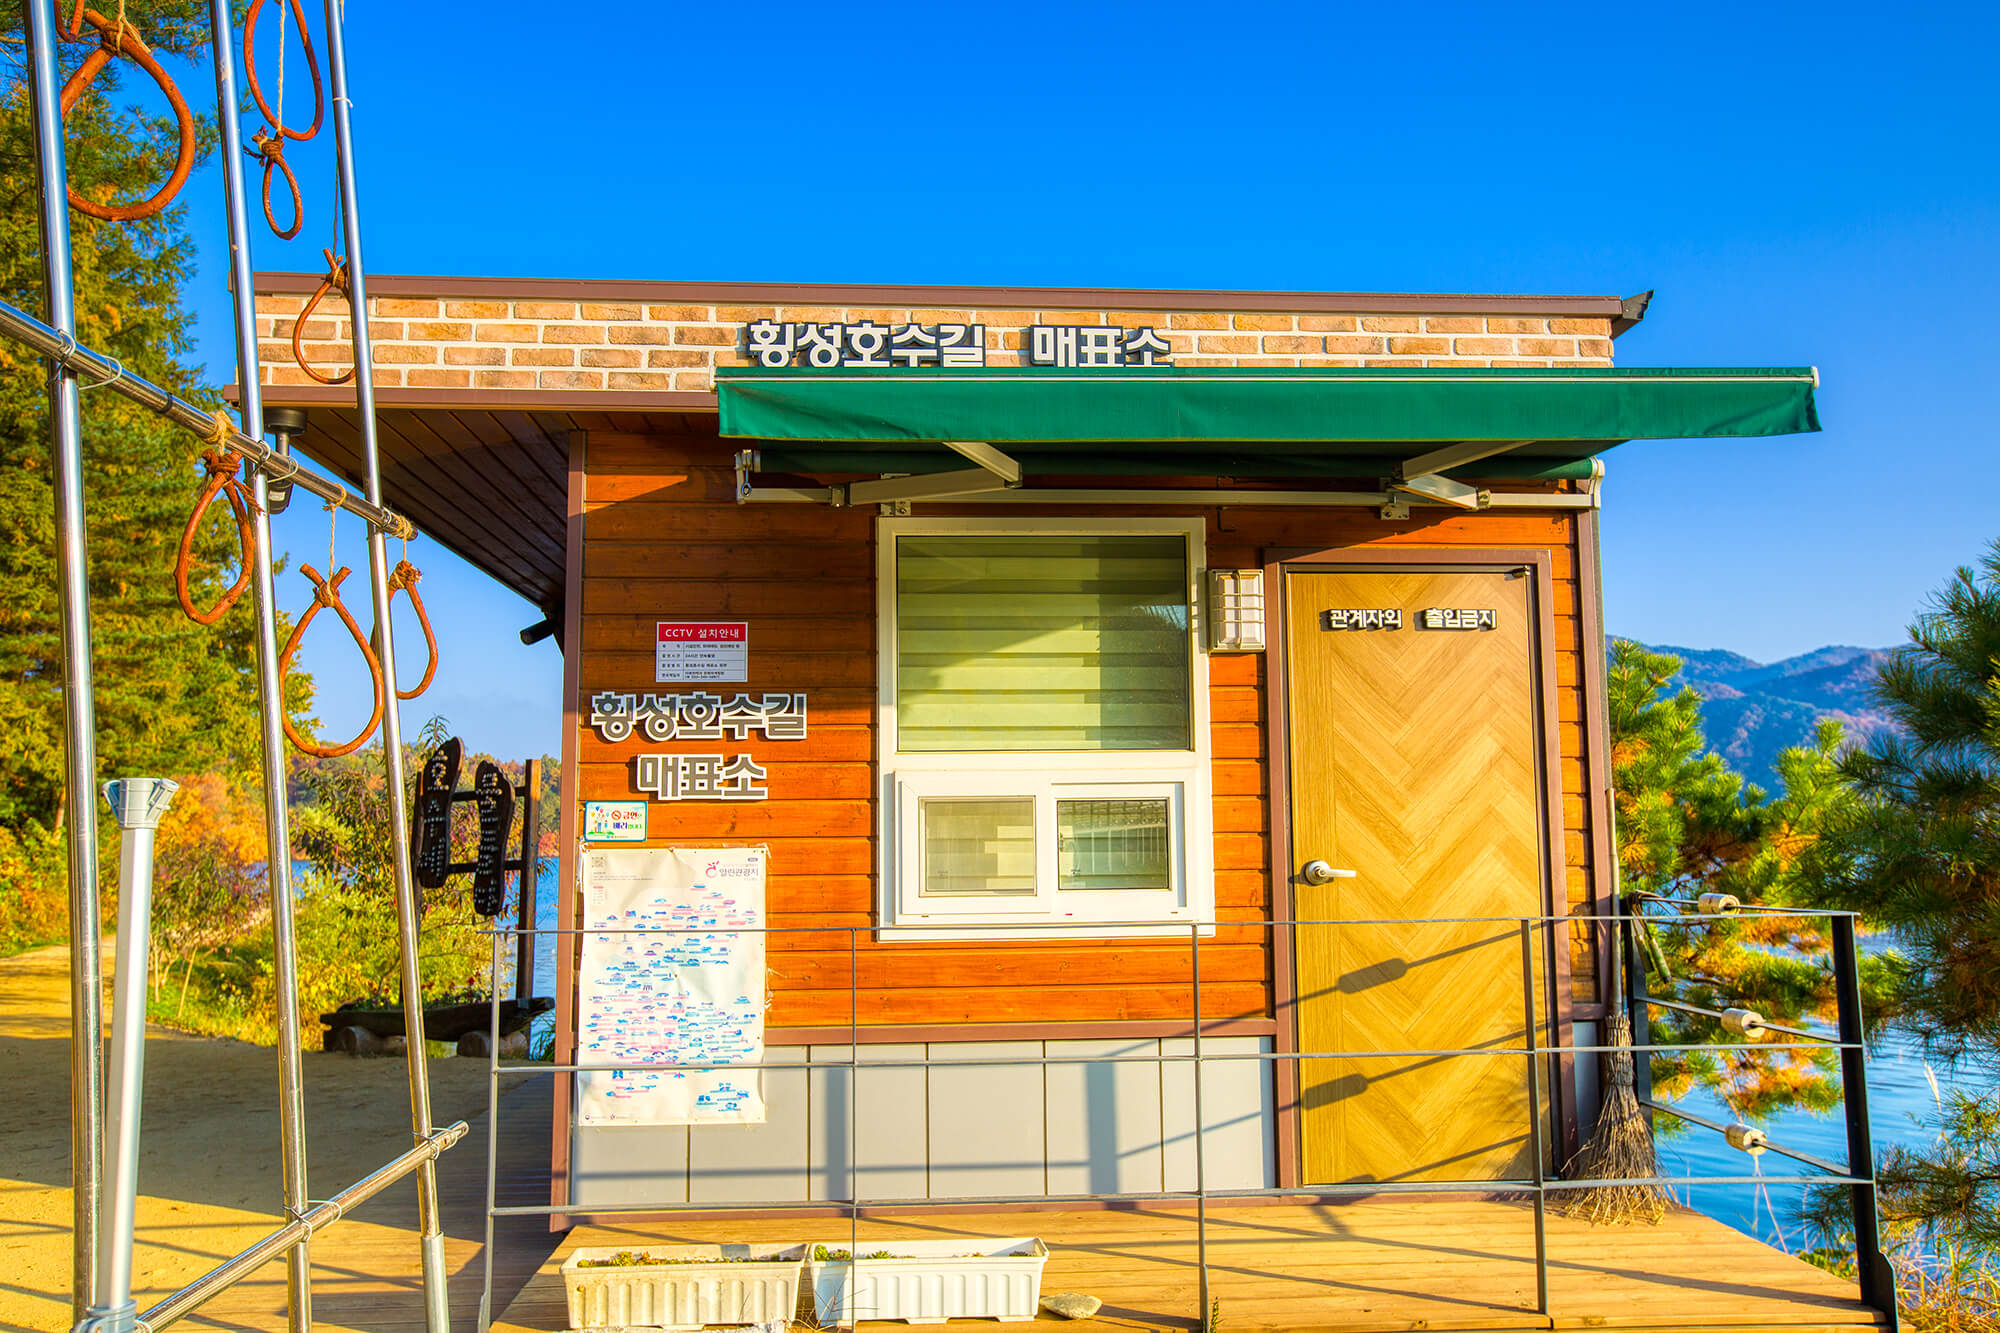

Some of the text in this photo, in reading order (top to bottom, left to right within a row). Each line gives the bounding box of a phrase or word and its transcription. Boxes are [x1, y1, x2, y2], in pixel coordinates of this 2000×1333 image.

[747, 319, 1173, 368] 횡성호수길 매표소
[665, 628, 740, 639] CCTV 설치안내
[1329, 607, 1497, 630] 관계자외 출입금지
[591, 691, 807, 741] 횡성호수길
[637, 754, 768, 800] 매표소
